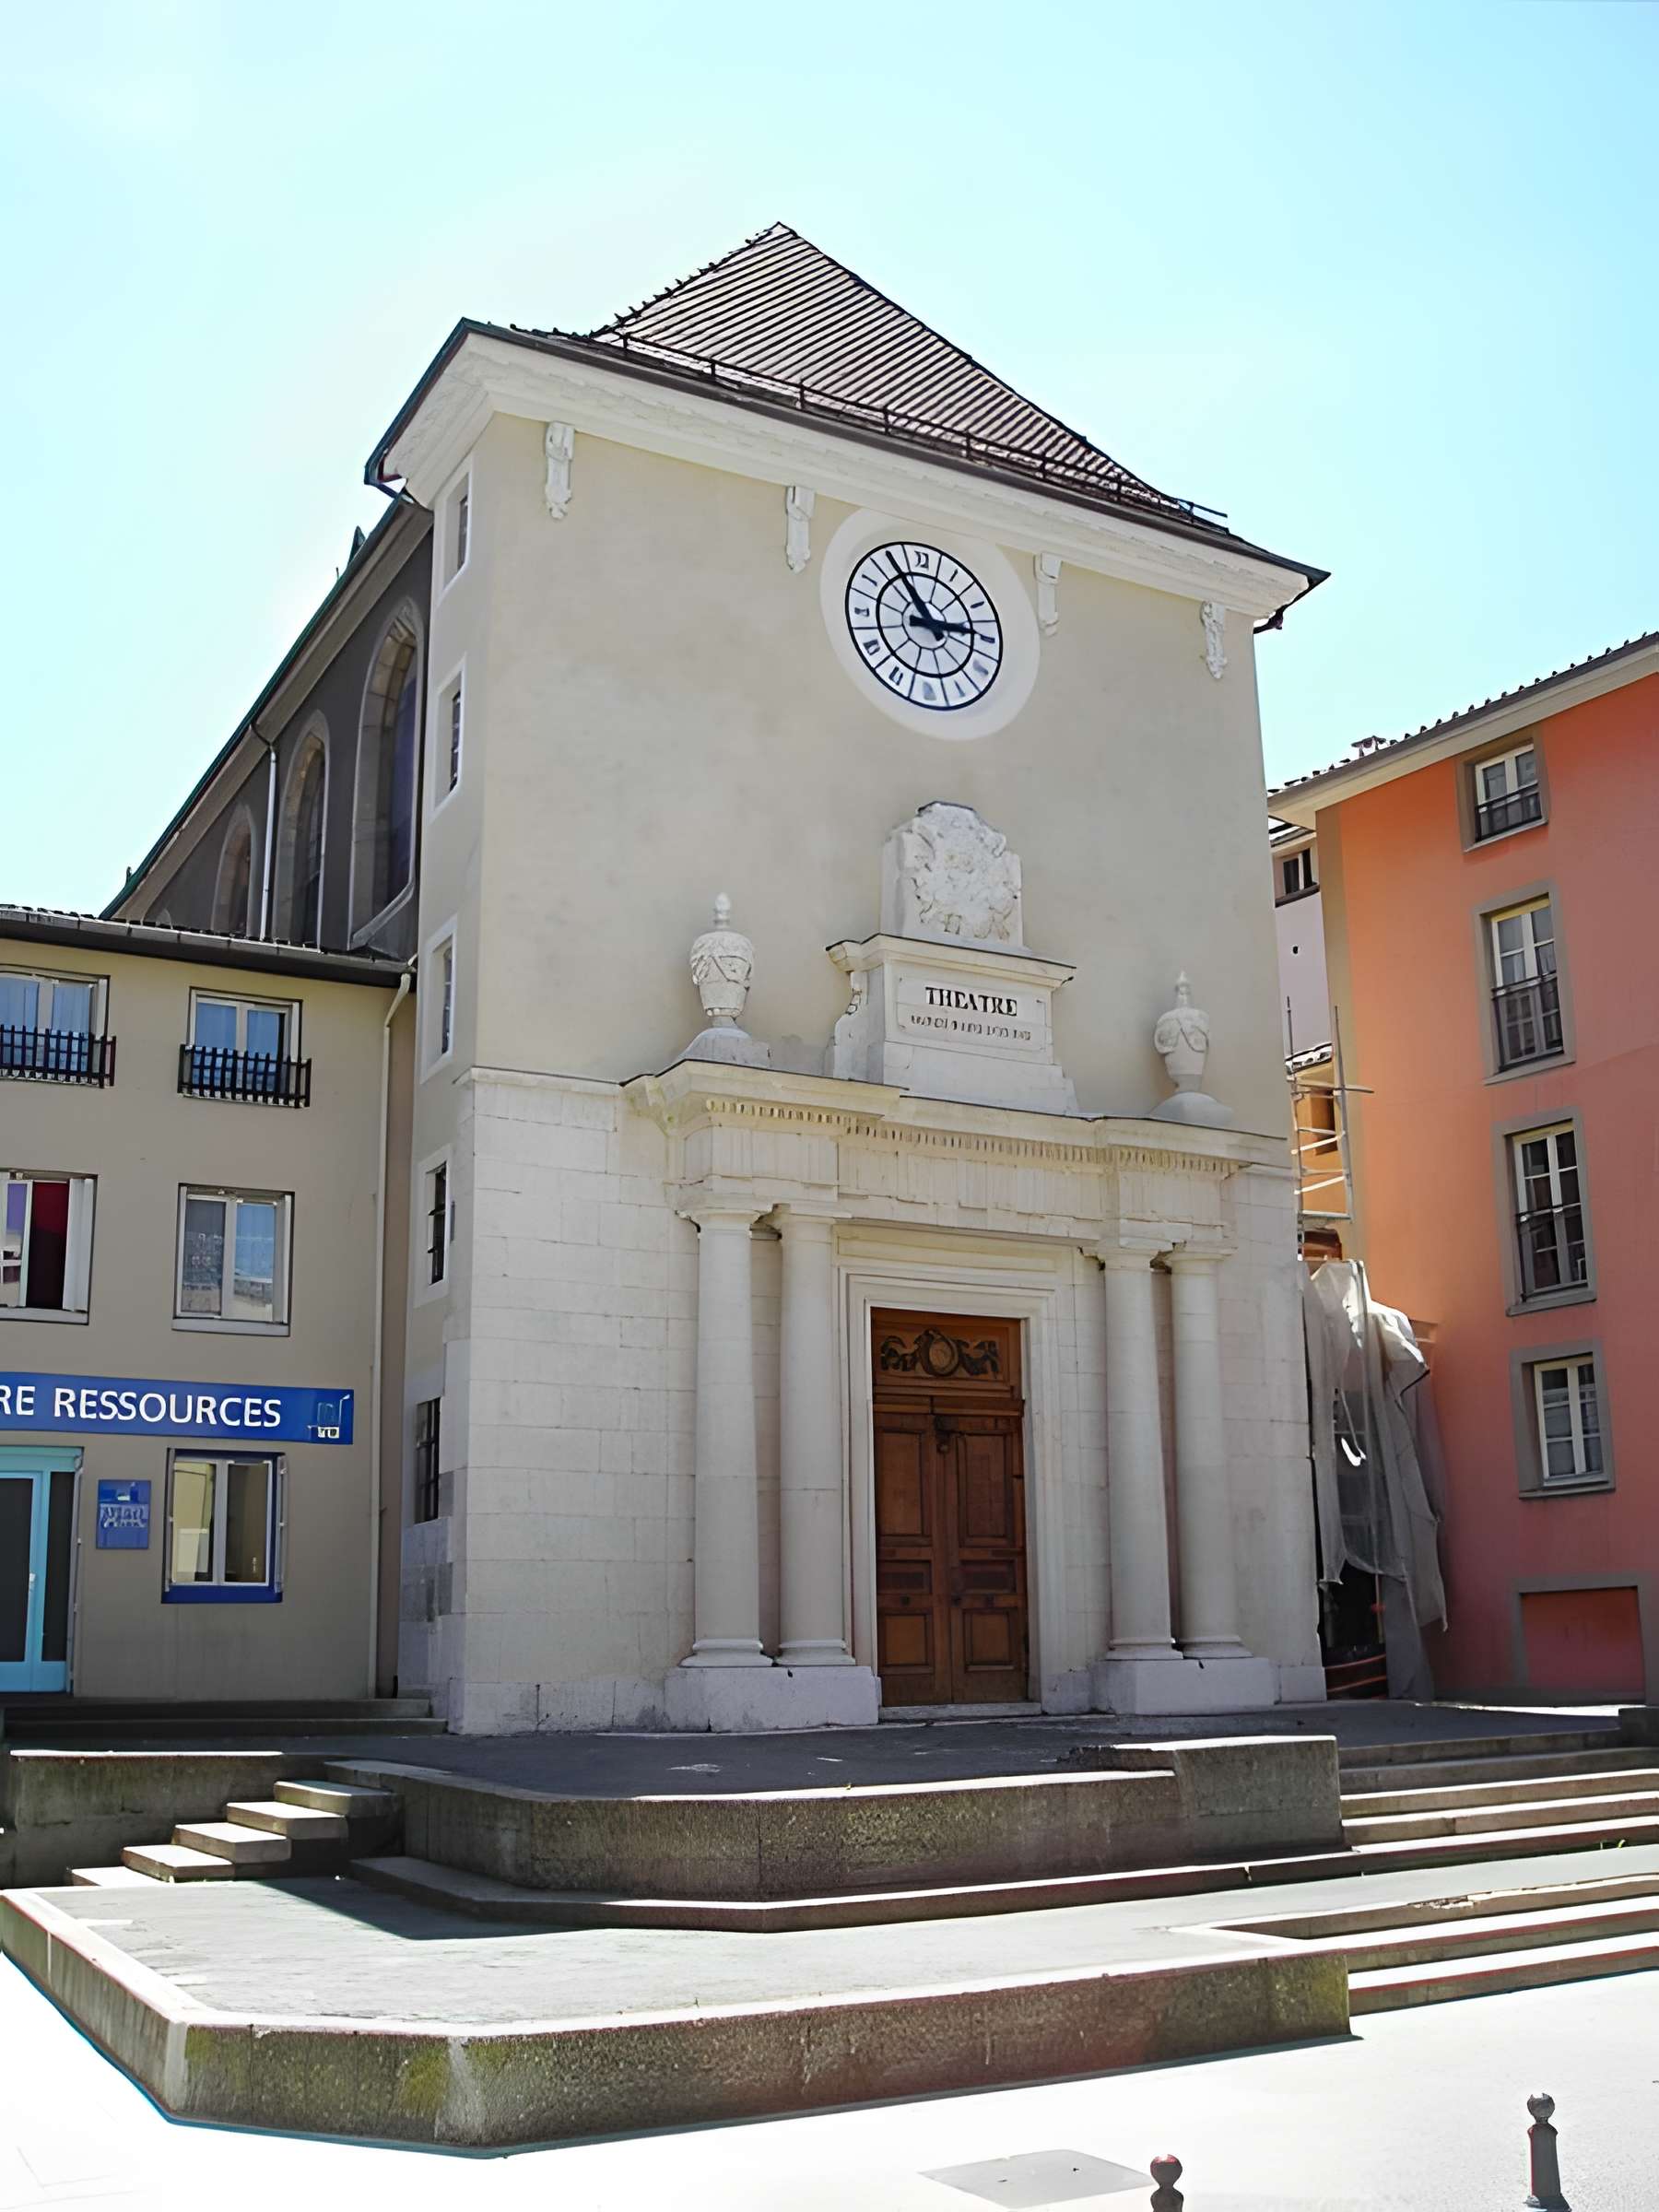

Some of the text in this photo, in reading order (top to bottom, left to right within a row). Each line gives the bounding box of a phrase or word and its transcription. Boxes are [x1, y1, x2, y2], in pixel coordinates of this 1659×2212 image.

[925, 986, 1018, 1017] THEATRE
[0, 1384, 281, 1428] RE RESSOURCES
